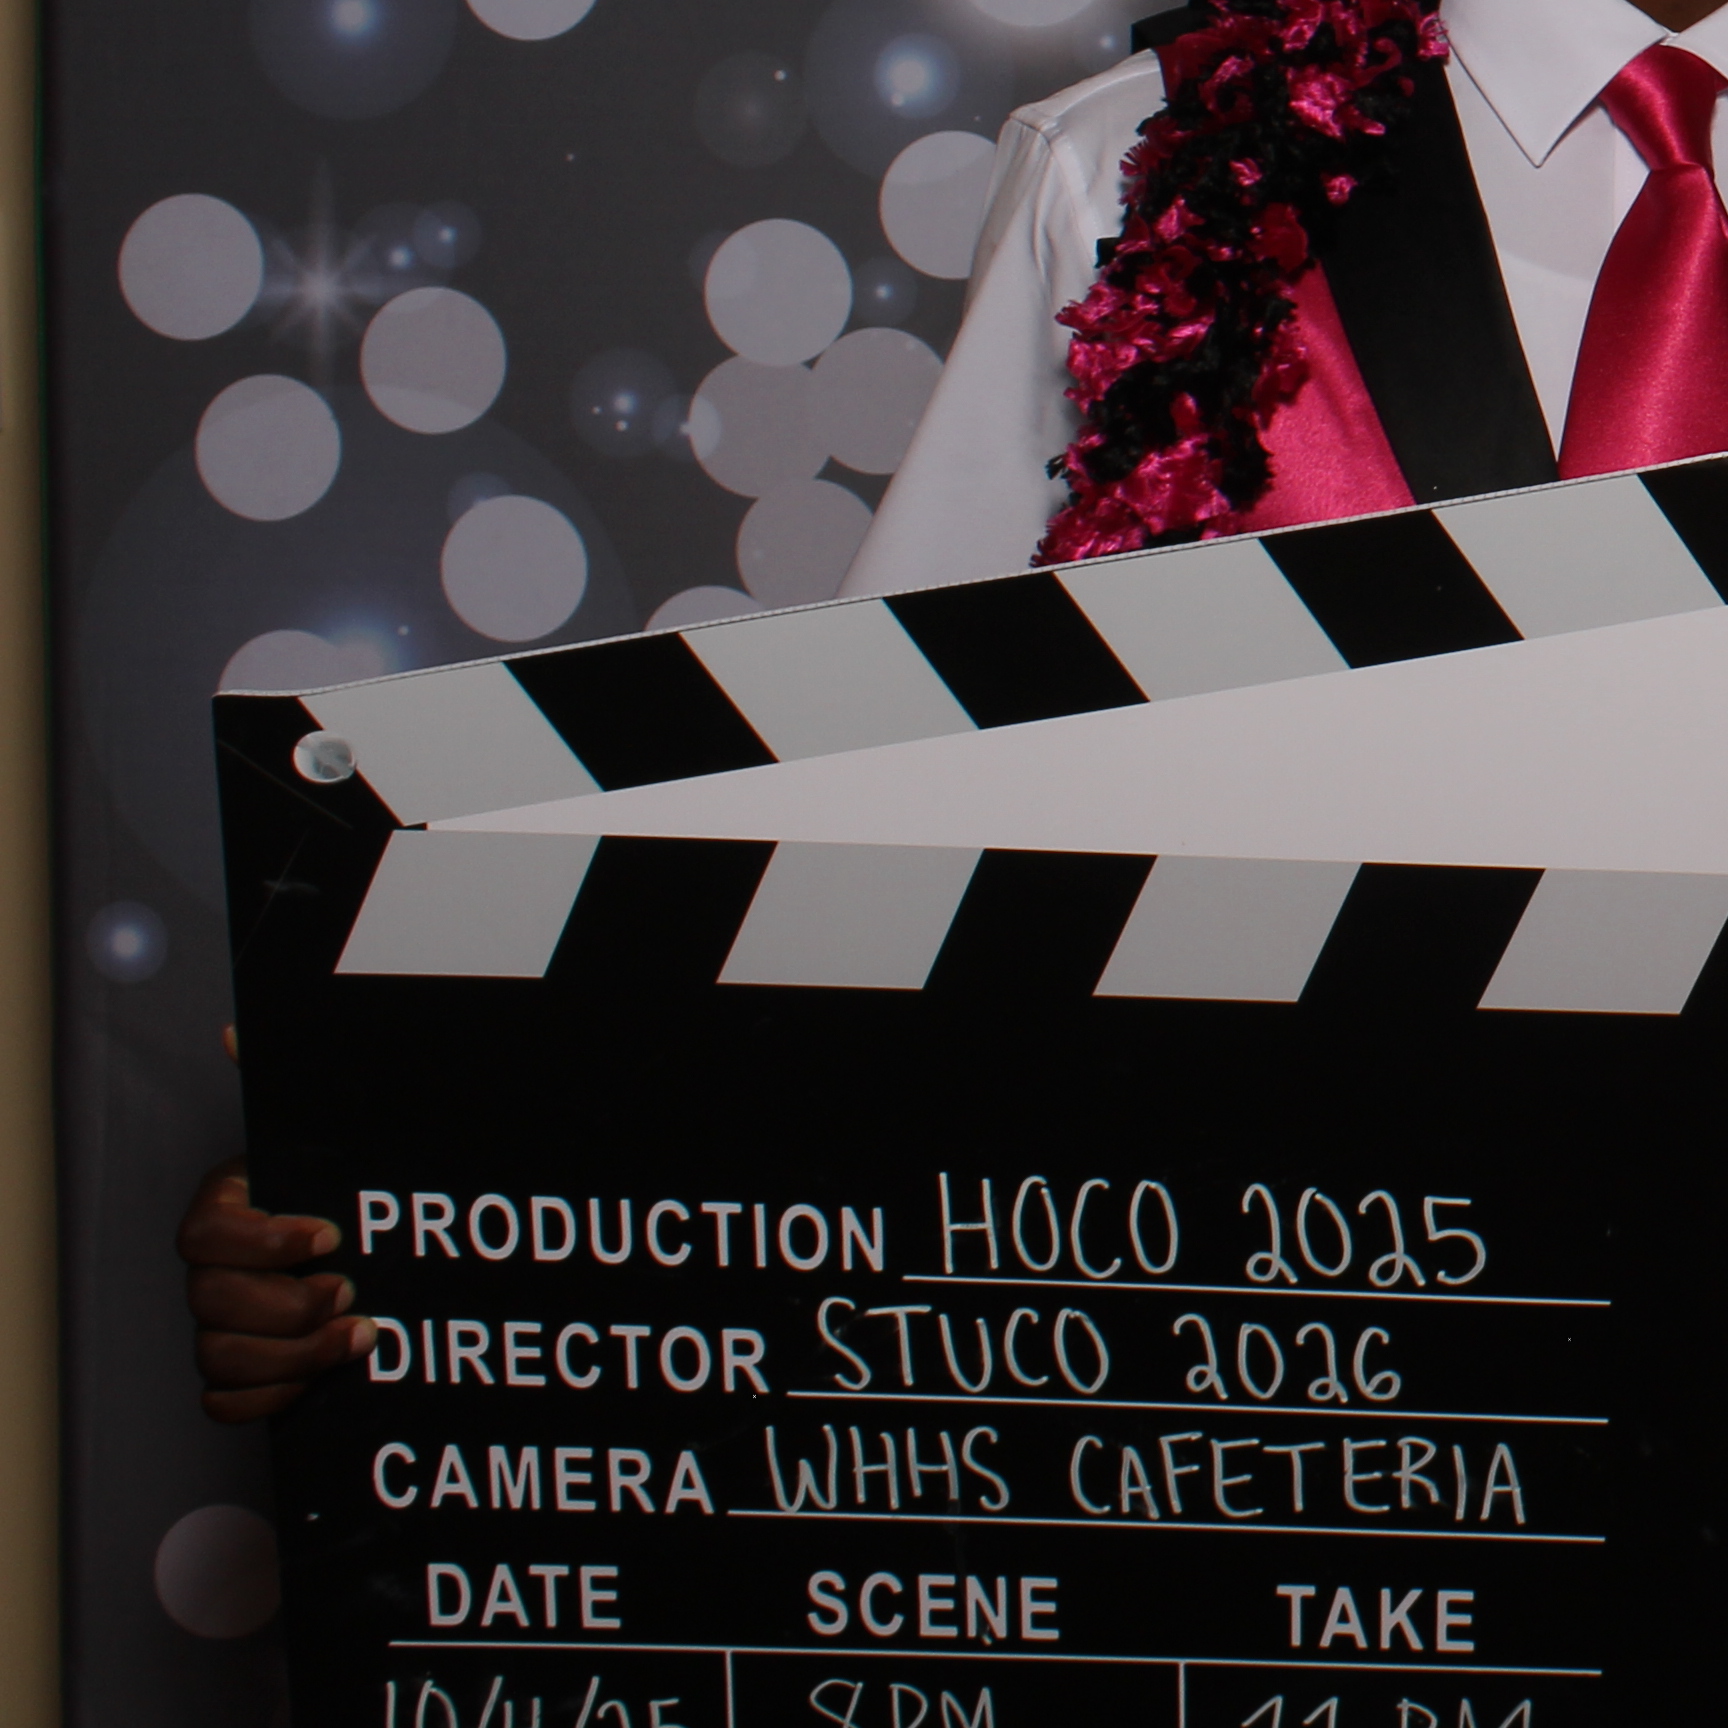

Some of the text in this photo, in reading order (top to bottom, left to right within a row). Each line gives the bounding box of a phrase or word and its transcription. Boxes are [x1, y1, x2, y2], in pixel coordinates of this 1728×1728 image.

[359, 1191, 883, 1272] PRODUCTION
[939, 1172, 1486, 1287] HOCO 2025
[368, 1317, 768, 1393] DIRECTOR
[816, 1296, 1400, 1405] STUCO 2026
[374, 1443, 713, 1514] CAMERA
[766, 1424, 1524, 1524] WHHS CAFETERIA
[428, 1564, 1474, 1652] DATE SCENE TAKE
